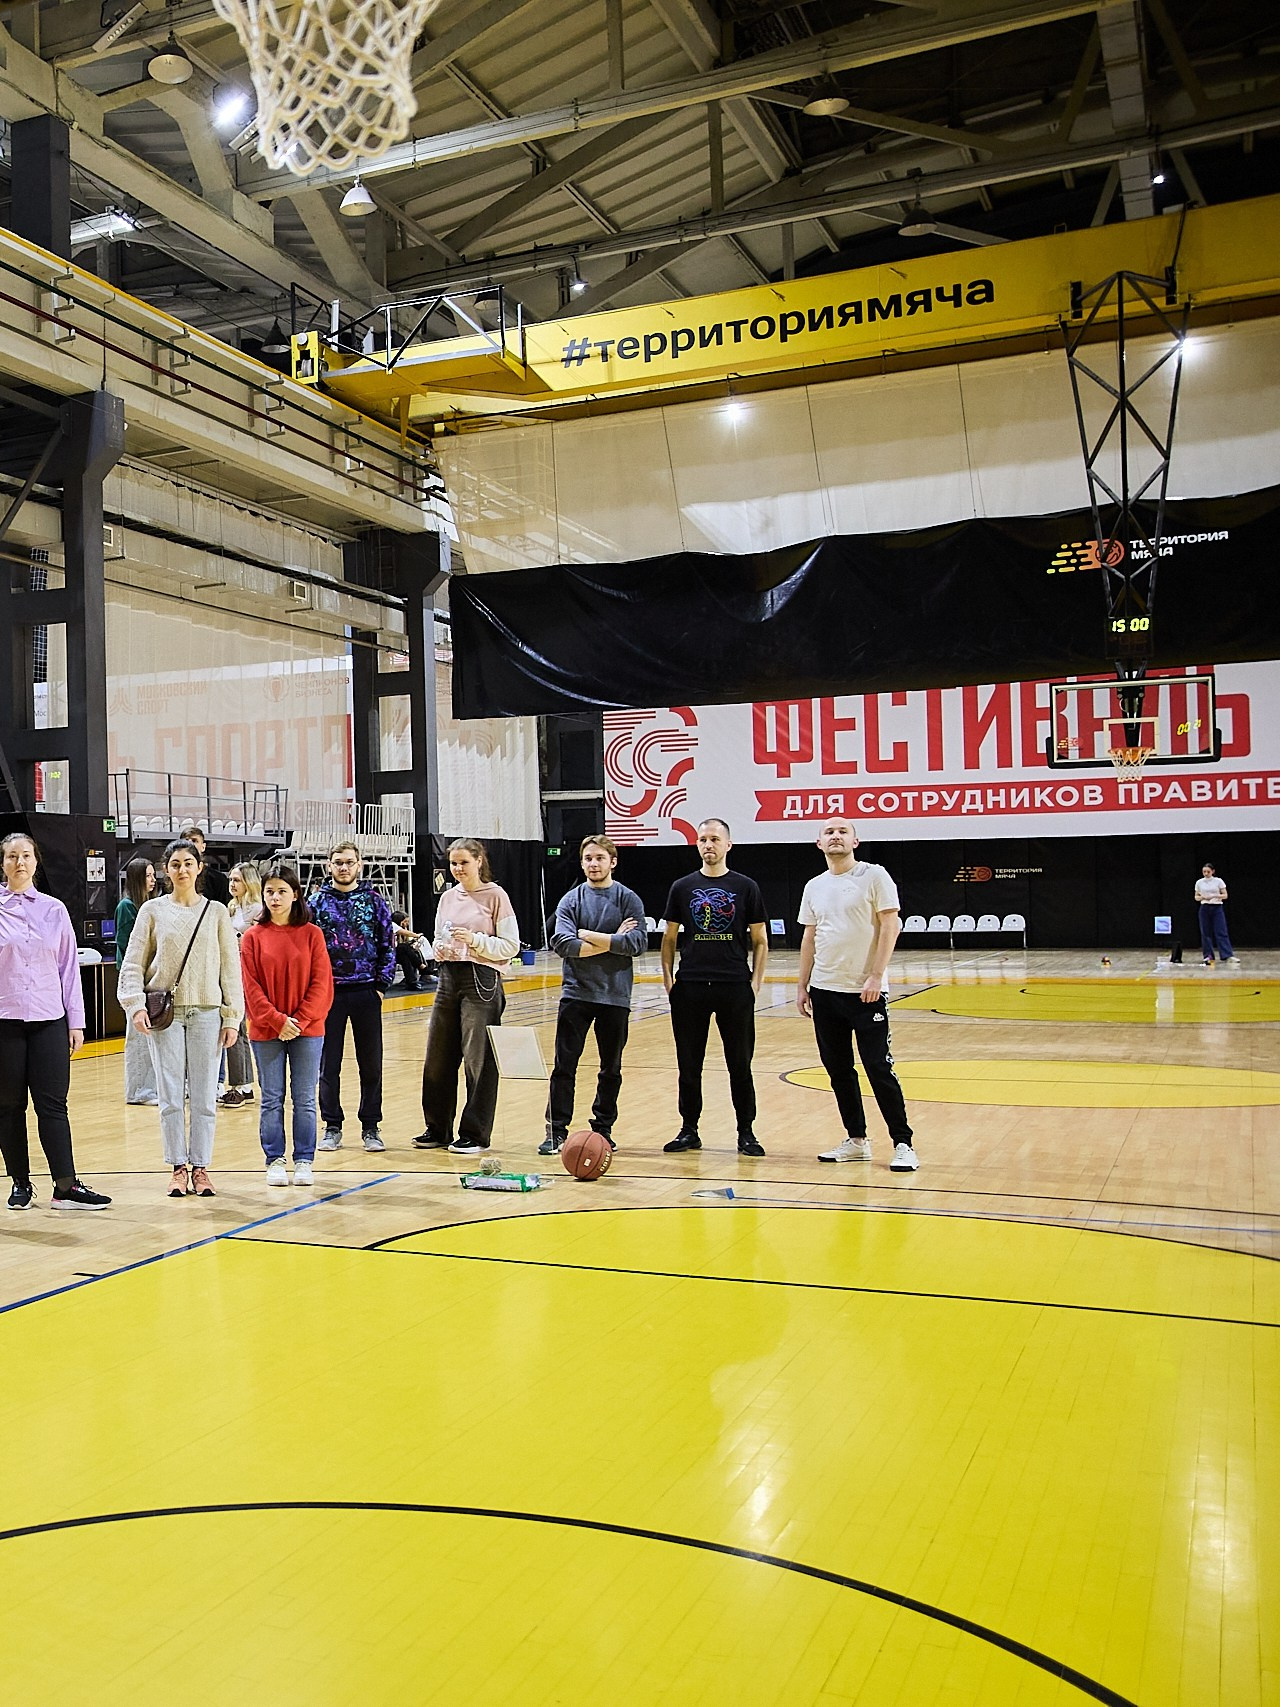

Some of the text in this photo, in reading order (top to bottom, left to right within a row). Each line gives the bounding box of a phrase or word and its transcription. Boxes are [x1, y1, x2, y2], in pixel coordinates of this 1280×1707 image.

[561, 278, 995, 368] #территориямяча
[783, 777, 1280, 818] ДЛЯ СОТРУДНИКОВ ПРАВИТЕ
